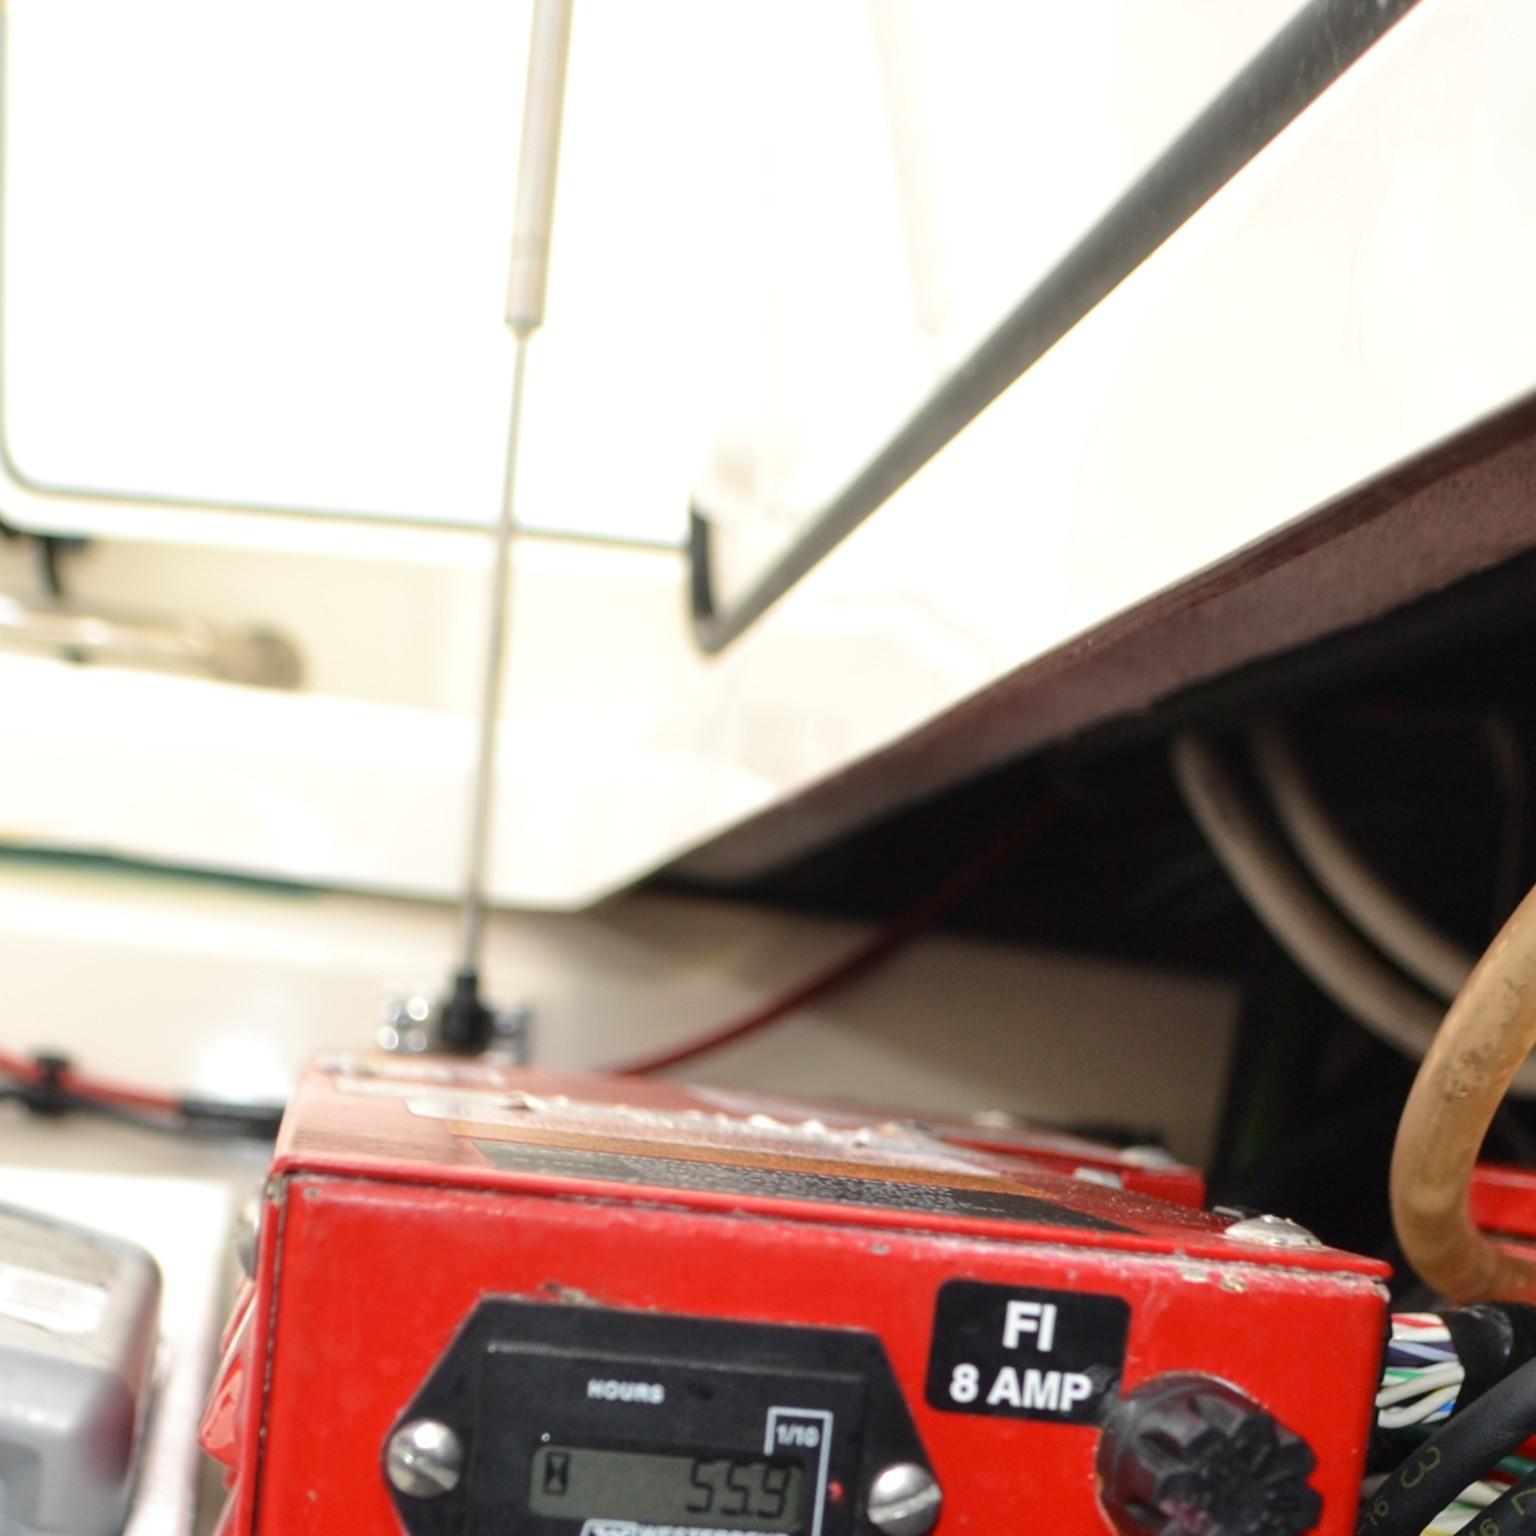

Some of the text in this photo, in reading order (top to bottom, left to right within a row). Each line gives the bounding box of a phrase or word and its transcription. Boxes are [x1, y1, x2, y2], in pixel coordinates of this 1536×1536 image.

[586, 1378, 665, 1404] HOURS
[948, 1362, 1093, 1413] 8 AMP
[775, 1423, 820, 1449] 1/10
